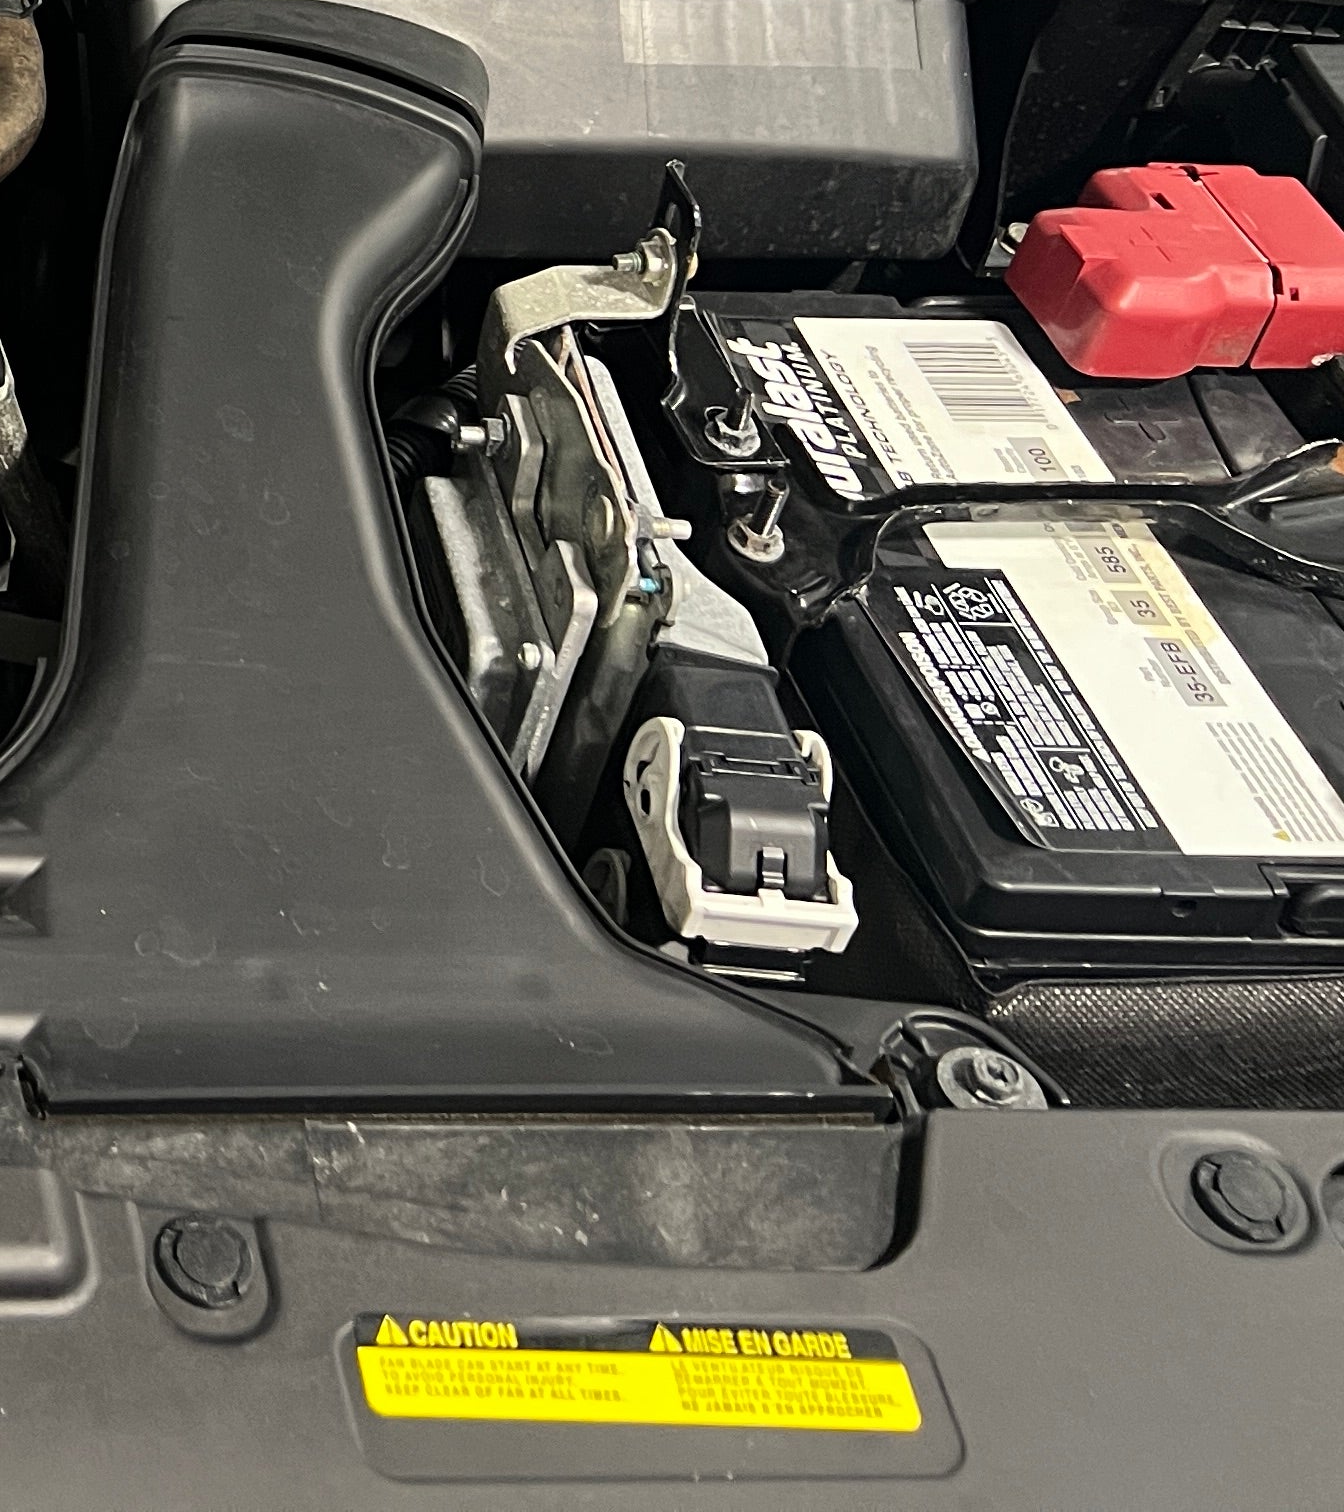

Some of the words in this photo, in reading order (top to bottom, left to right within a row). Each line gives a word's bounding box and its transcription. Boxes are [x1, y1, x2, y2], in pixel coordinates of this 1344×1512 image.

[820, 349, 903, 464] TECHNOLOGY
[1028, 448, 1056, 472] 100
[1095, 546, 1126, 573] 585
[1130, 600, 1156, 618] 35
[1160, 641, 1214, 703] 35-EFB
[408, 1319, 519, 1349] CAUTION
[681, 1327, 738, 1355] MISE
[737, 1329, 773, 1356] EN
[773, 1330, 852, 1359] GARDE
